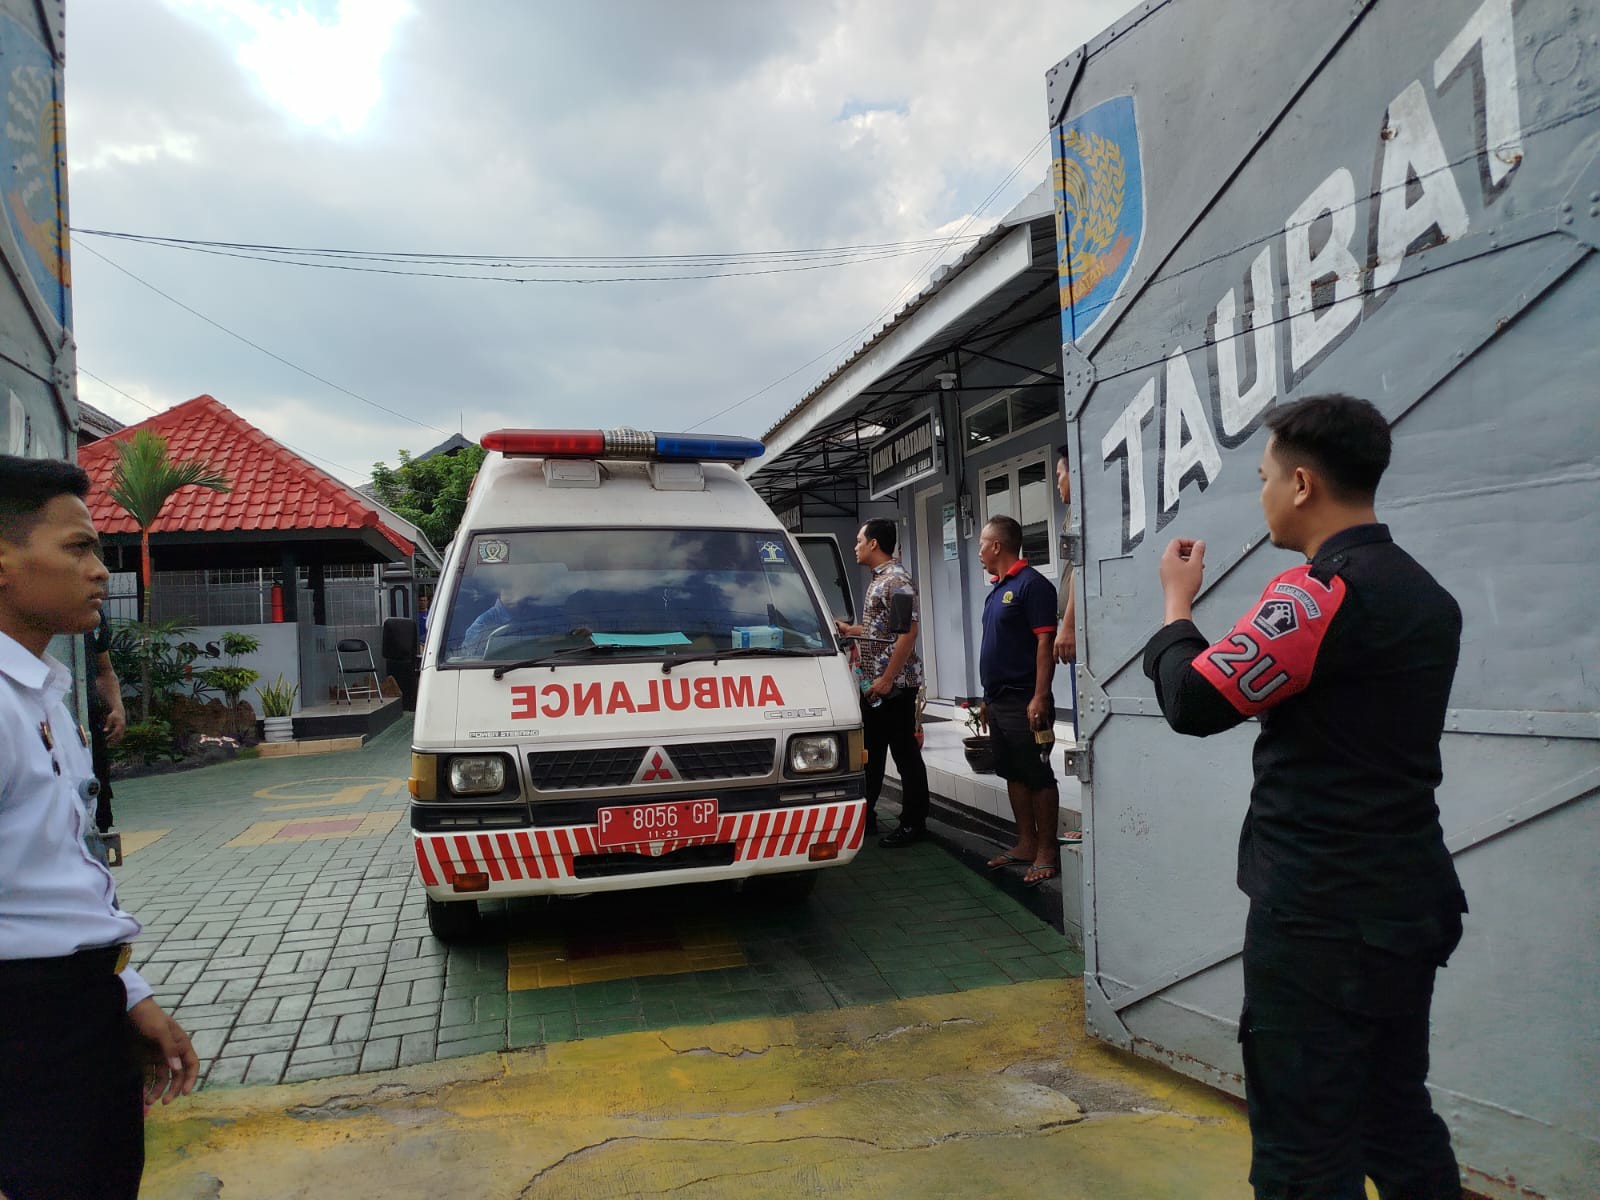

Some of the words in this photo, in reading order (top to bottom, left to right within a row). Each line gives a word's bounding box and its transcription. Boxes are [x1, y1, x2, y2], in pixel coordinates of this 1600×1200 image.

[1101, 0, 1525, 545] TAUBAT
[895, 422, 932, 464] PRATAMA
[1207, 632, 1290, 702] 2U
[764, 707, 827, 720] COLT
[601, 810, 612, 833] P
[633, 806, 678, 830] 8056
[692, 802, 715, 824] GP
